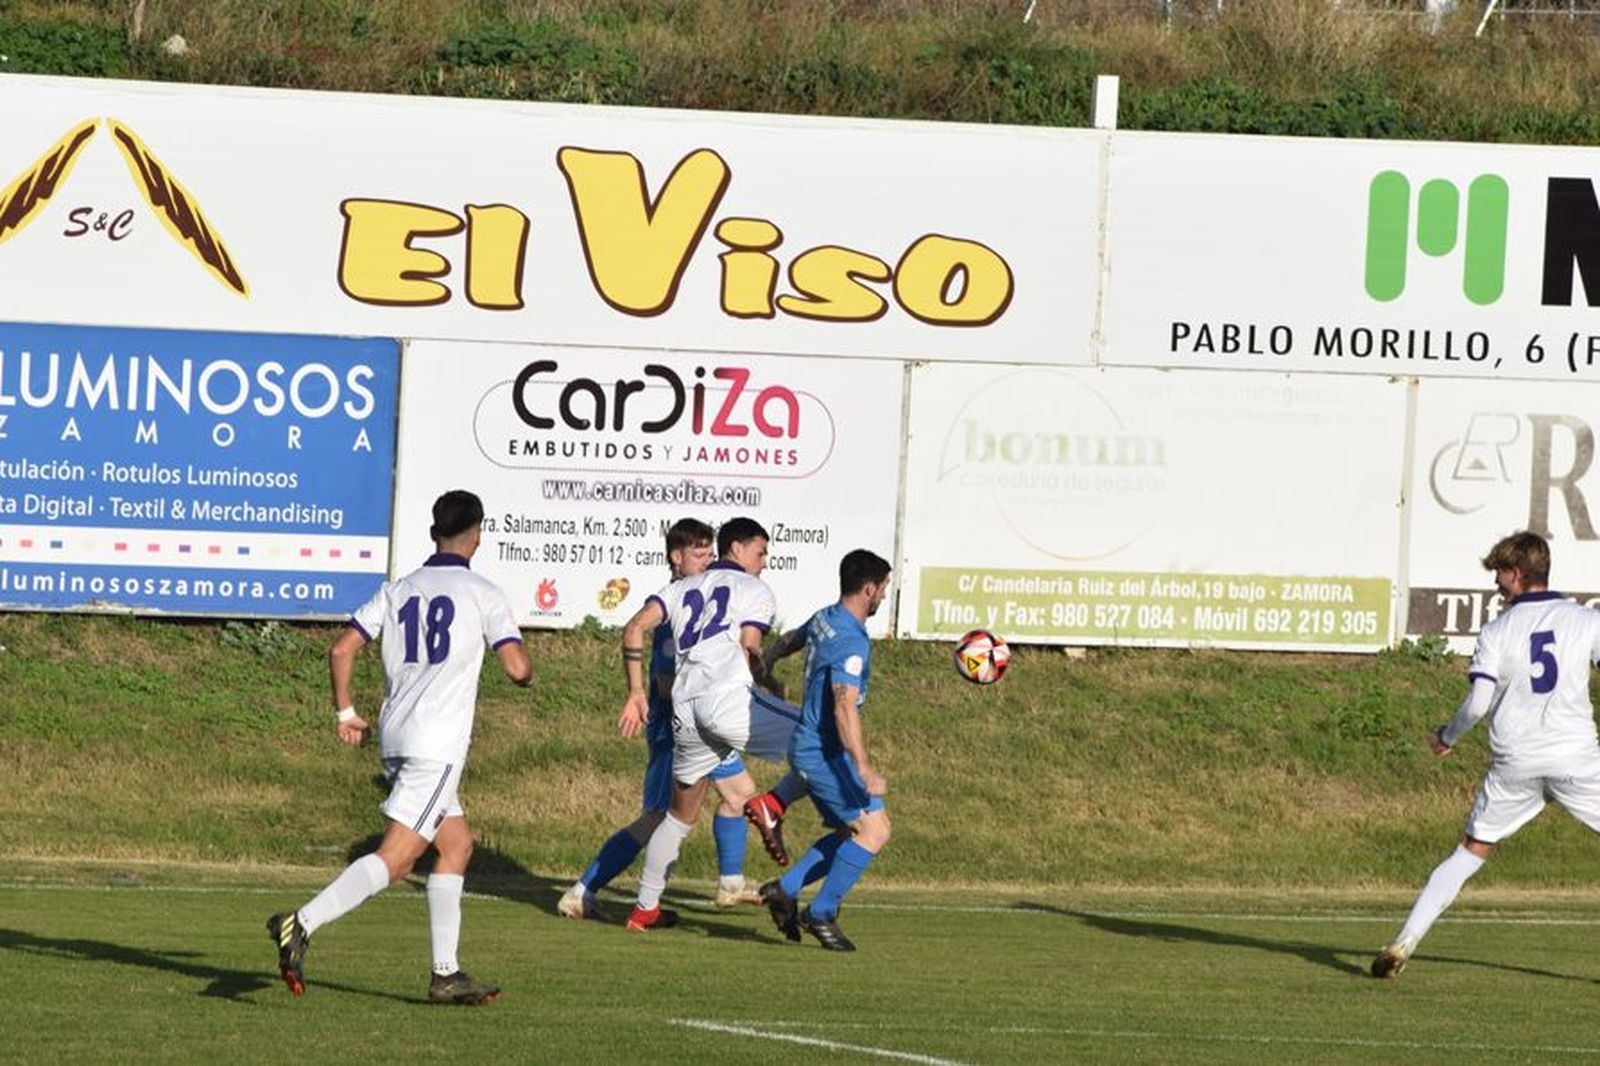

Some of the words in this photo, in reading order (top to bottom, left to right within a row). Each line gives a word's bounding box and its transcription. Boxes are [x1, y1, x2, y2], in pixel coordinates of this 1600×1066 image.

[63, 206, 135, 241] S&C
[1171, 322, 1293, 355] PABLO
[1314, 327, 1502, 368] MORILLO,
[1525, 334, 1545, 363] 6
[0, 351, 375, 420] LUMINOSOS
[509, 439, 653, 461] EMBUTIDOS
[664, 445, 676, 461] Y
[683, 447, 800, 466] JAMONES
[961, 417, 1166, 468] bonum
[103, 461, 182, 485] Rotulos
[187, 466, 299, 489] Luminosos
[24, 493, 93, 520] Digital
[109, 496, 166, 519] Textil
[171, 500, 187, 519] &
[192, 501, 344, 528] Merchandising
[542, 480, 761, 507] www.carnicasdiaz.com
[503, 513, 579, 537] Salamanca,
[583, 517, 609, 536] Km.
[771, 523, 829, 548] (Zamora)
[543, 543, 567, 564] 980
[570, 544, 586, 564] 57
[589, 545, 603, 565] 01
[610, 545, 623, 566] 12
[959, 574, 977, 593] C/
[983, 576, 1073, 596] Candelaria
[1078, 578, 1115, 597] Ruiz
[1120, 579, 1145, 597] del
[1228, 583, 1266, 603] bajo
[1281, 584, 1355, 603] ZAMORA
[398, 595, 456, 665] 18
[678, 586, 731, 653] 22
[987, 606, 999, 629] y
[1004, 602, 1045, 626] Fax:
[1052, 604, 1089, 627] 980
[1095, 604, 1132, 628] 527
[1137, 605, 1175, 629] 084
[1194, 606, 1248, 632] Móvil
[1254, 608, 1291, 633] 692
[1298, 609, 1335, 635] 219
[1341, 611, 1377, 635] 305
[1529, 630, 1559, 694] 5
